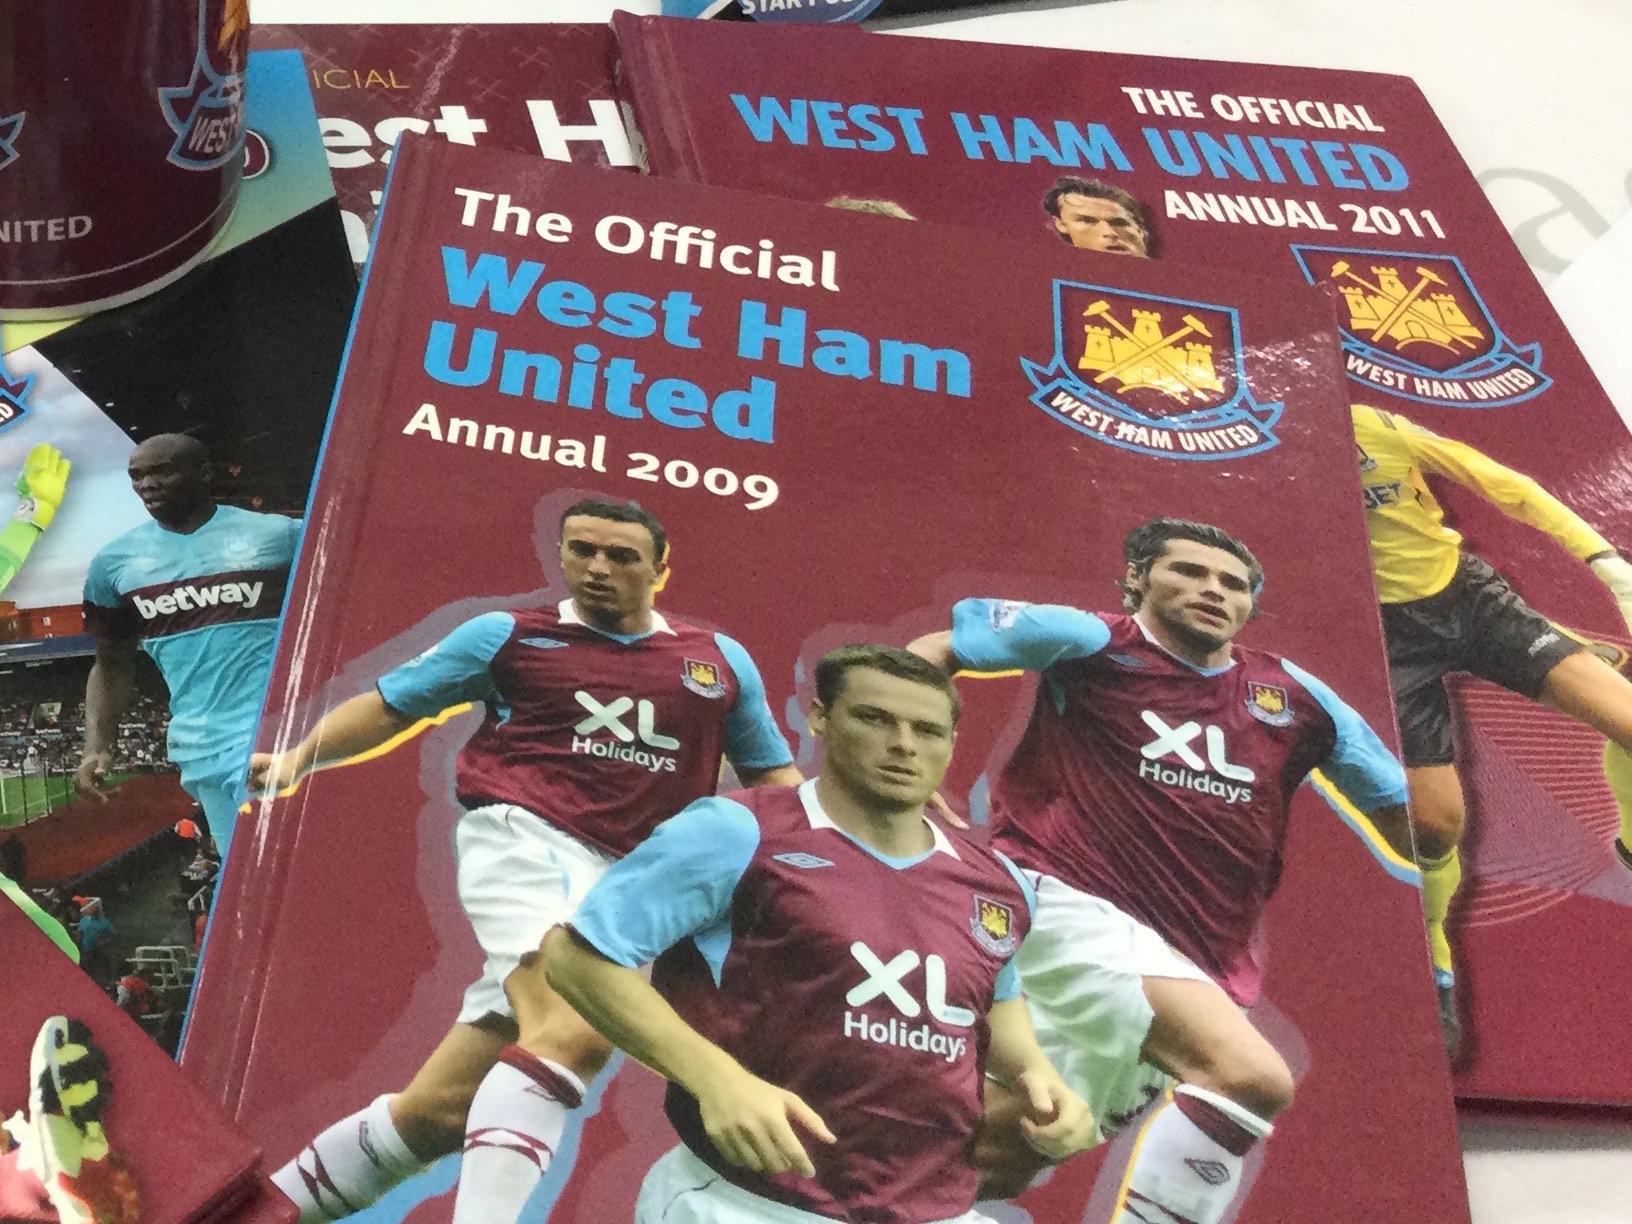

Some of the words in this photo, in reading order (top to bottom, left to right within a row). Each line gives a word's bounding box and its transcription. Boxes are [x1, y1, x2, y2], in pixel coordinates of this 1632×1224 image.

[313, 68, 410, 90] ICIAL
[1121, 86, 1205, 119] THE
[1210, 93, 1385, 133] OFFICIAL
[317, 105, 488, 168] est
[730, 92, 928, 157] WEST
[952, 111, 1134, 173] HAM
[1148, 128, 1410, 193] UNITED
[453, 187, 572, 244] The
[594, 215, 840, 292] Official
[1165, 190, 1338, 232] ANNUAL
[1339, 203, 1446, 239] 2011
[441, 245, 702, 349] West
[737, 299, 971, 398] Ham
[422, 320, 776, 443] United
[1346, 354, 1407, 390] WEST
[1414, 377, 1465, 400] HAM
[1467, 368, 1536, 401] UNITED
[1050, 391, 1111, 433] WEST
[1115, 420, 1175, 450] HAM
[1181, 422, 1259, 453] UNITED
[402, 403, 606, 473] Annual
[626, 451, 780, 511] 2009
[132, 579, 263, 621] betway
[572, 690, 680, 750] XL
[1139, 710, 1256, 783] XL
[571, 735, 677, 773] Holidays
[1138, 758, 1253, 804] Holidays
[845, 941, 975, 1027] XL
